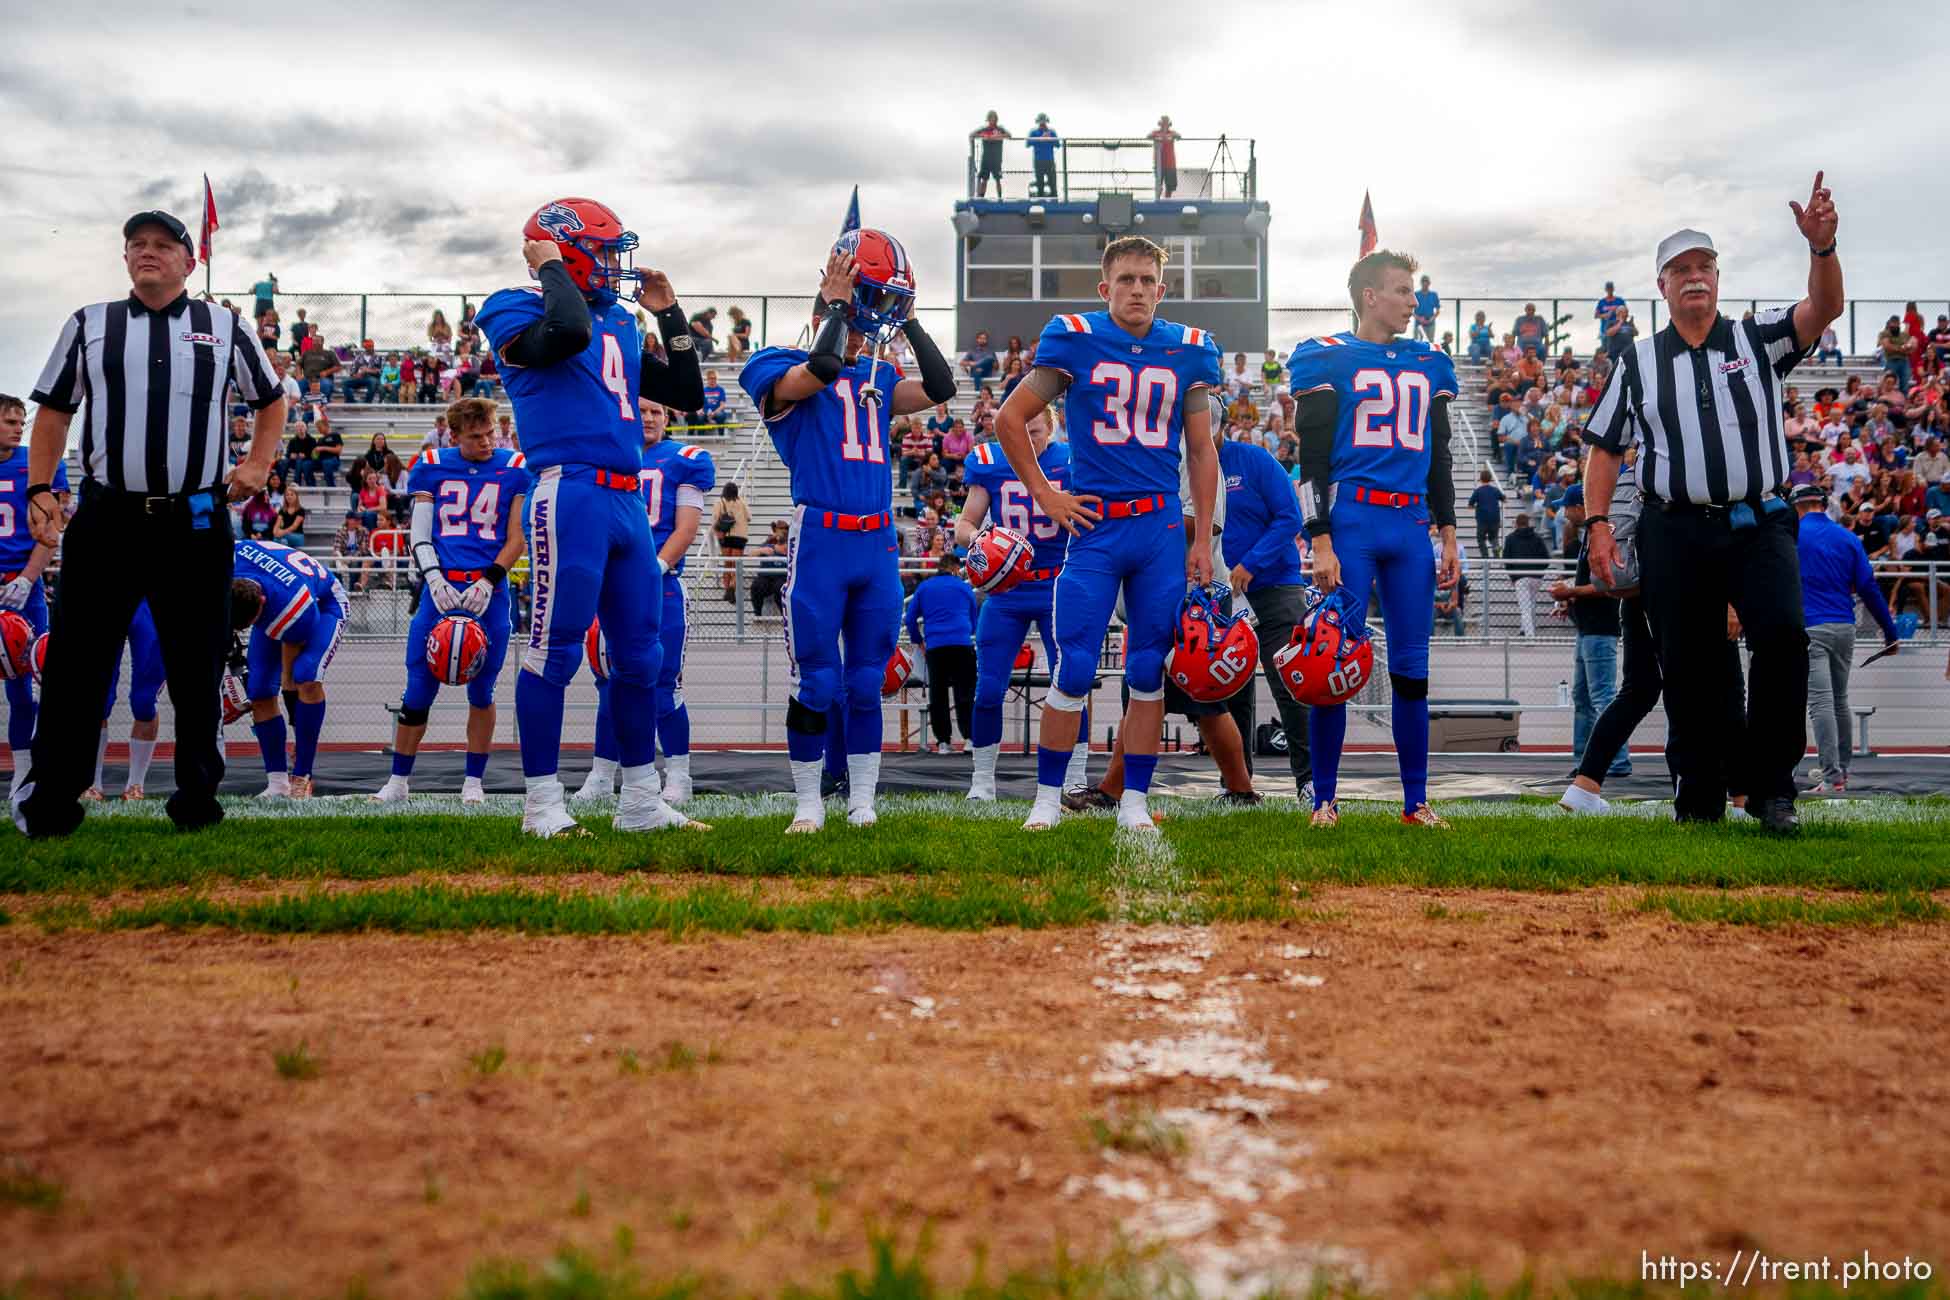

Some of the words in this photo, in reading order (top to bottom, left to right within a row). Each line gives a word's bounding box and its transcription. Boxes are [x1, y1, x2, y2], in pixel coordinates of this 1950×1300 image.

[602, 333, 635, 421] 4
[1090, 361, 1178, 448] 30
[1352, 368, 1430, 452] 20
[834, 377, 884, 464] 11
[439, 480, 499, 540] 24
[534, 498, 549, 566] WATER
[237, 545, 297, 587] WILDCATS
[529, 569, 549, 650] CANYON
[1208, 645, 1247, 685] 30
[1327, 659, 1363, 696] 20
